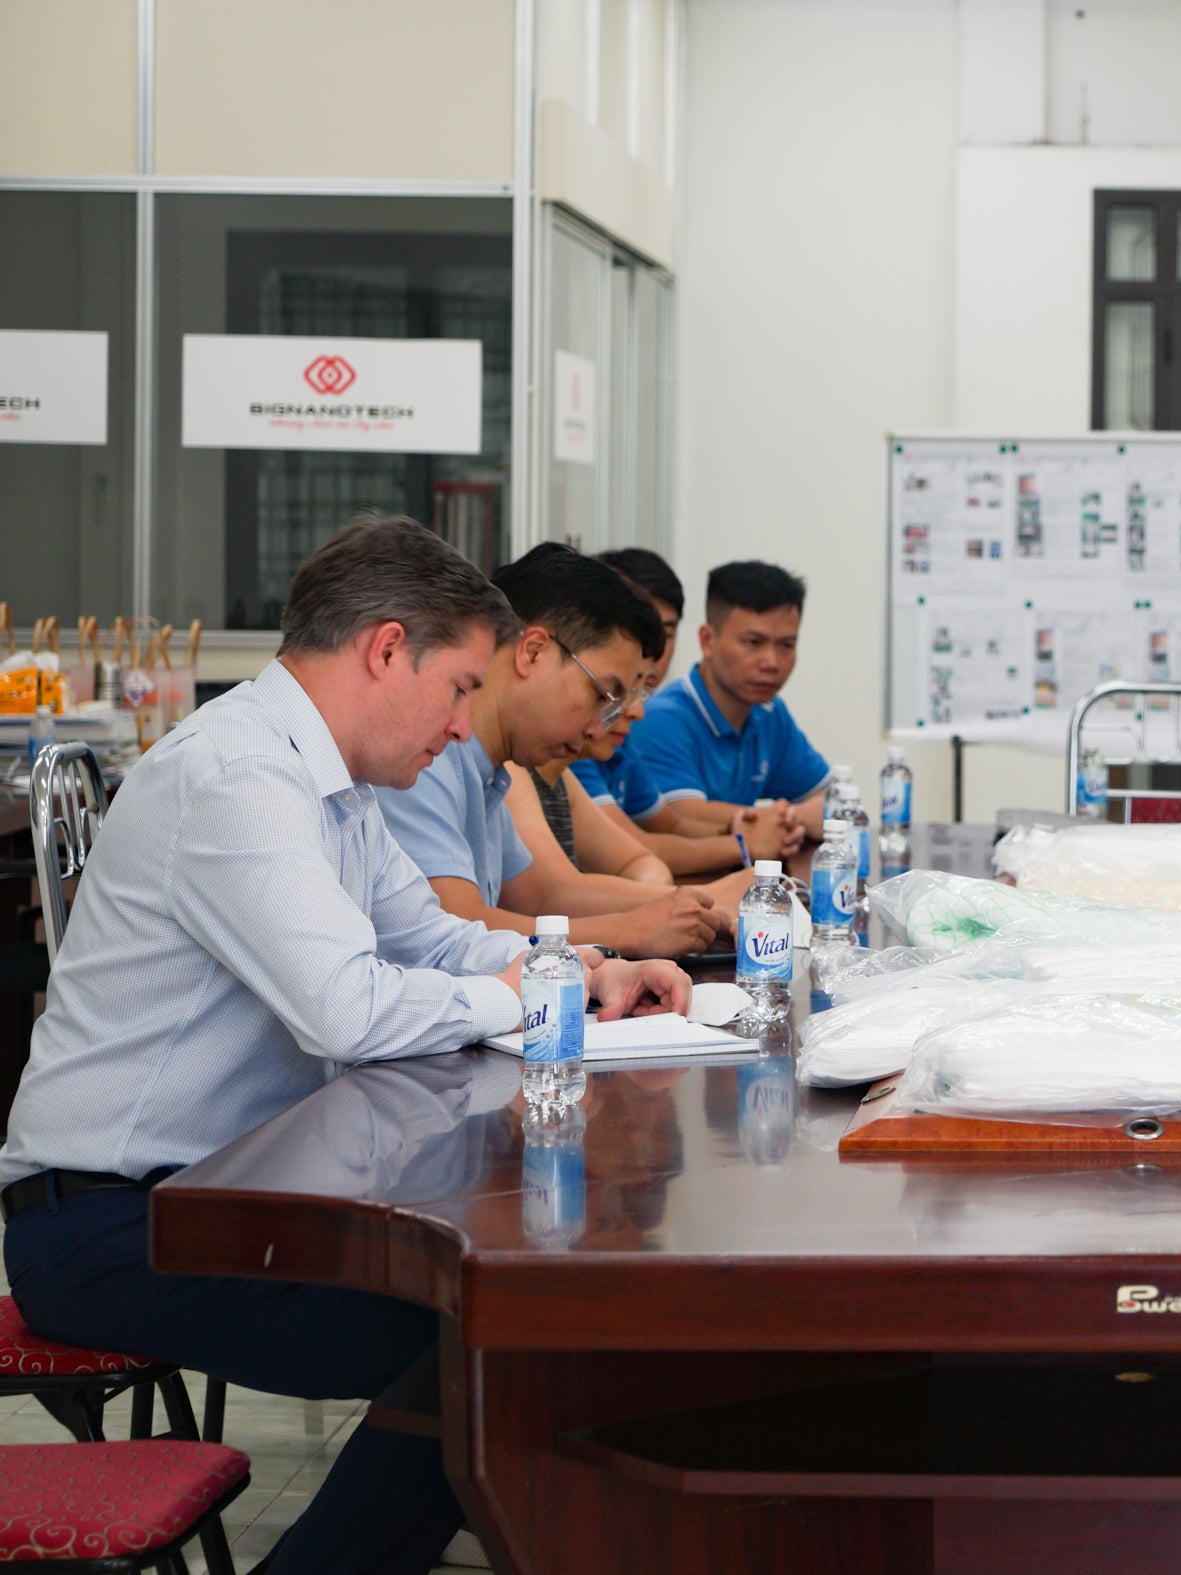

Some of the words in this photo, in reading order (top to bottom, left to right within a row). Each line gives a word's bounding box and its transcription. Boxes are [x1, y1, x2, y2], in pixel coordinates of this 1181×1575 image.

[250, 402, 414, 419] BIGNANOTECH
[751, 931, 790, 958] Vital
[522, 1003, 549, 1033] ital
